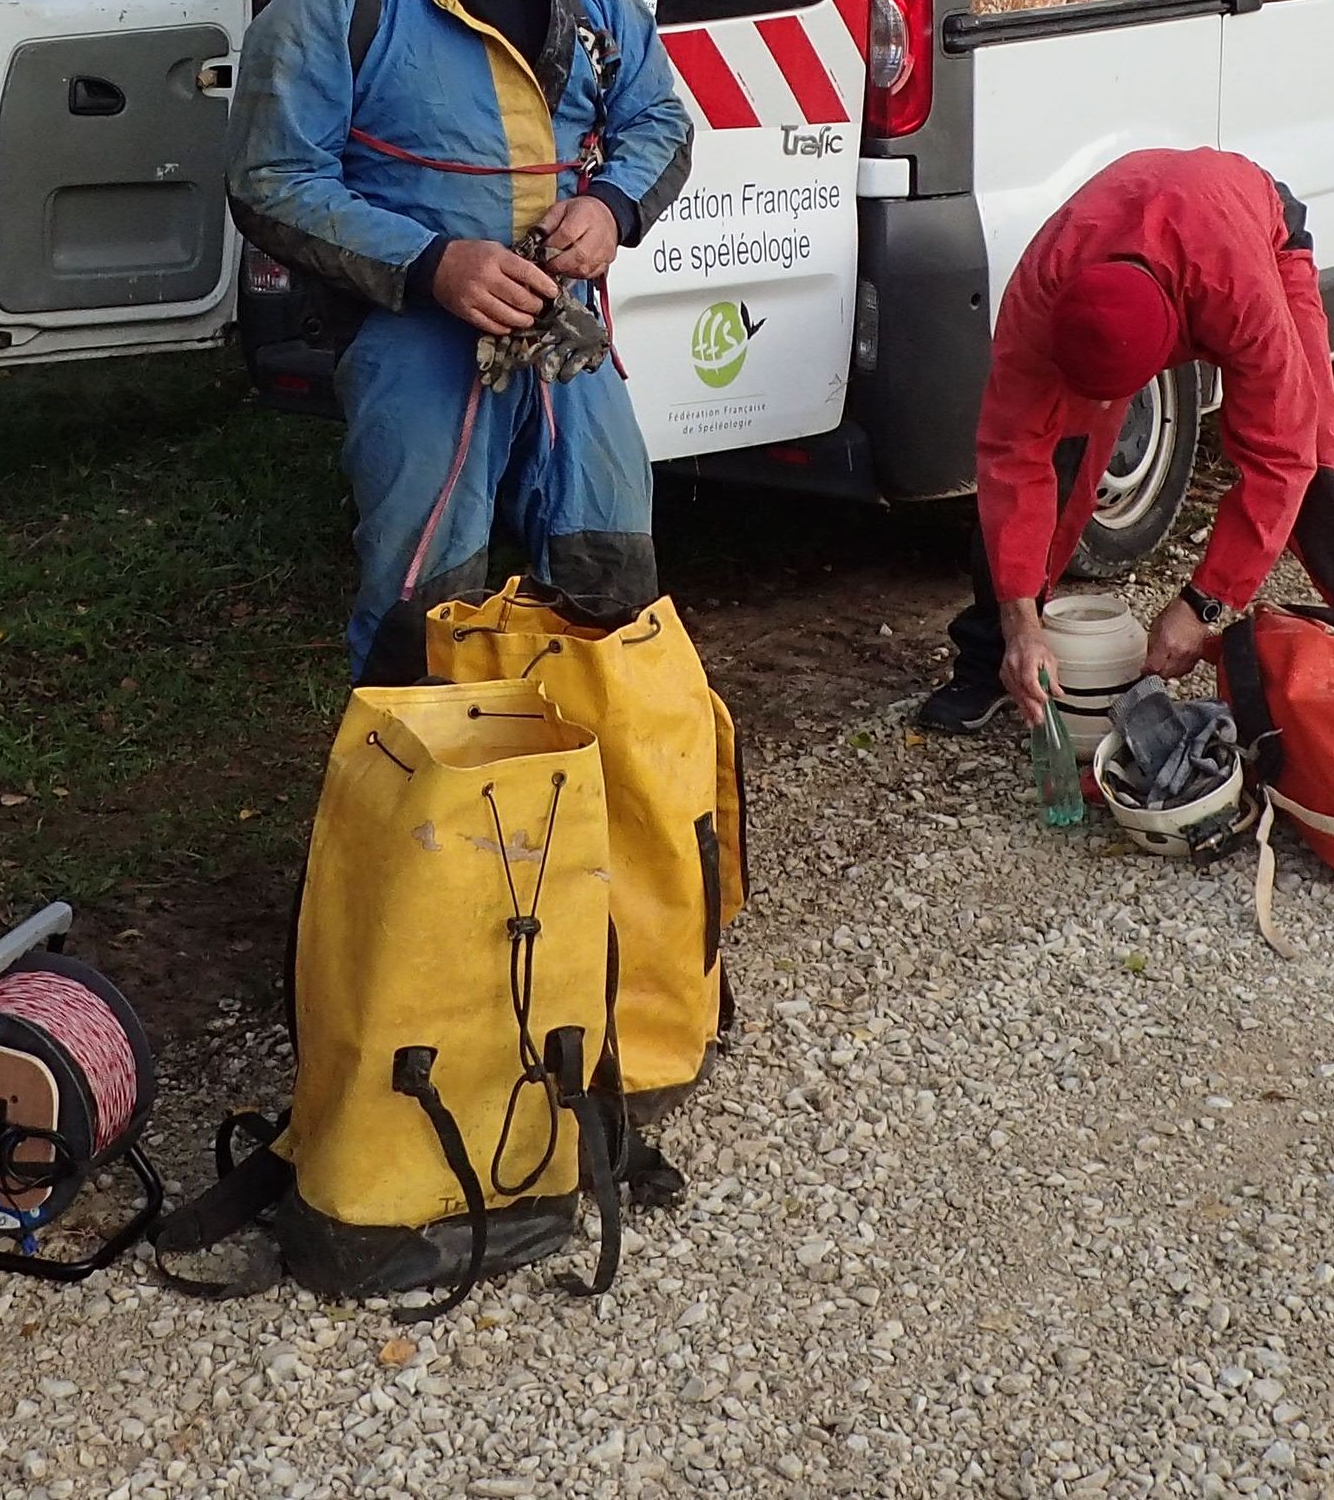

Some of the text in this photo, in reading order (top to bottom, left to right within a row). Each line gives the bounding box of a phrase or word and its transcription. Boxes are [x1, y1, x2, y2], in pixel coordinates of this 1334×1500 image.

[780, 123, 844, 157] Trafic
[658, 179, 840, 222] ration Française
[653, 228, 811, 277] de spéléologie
[668, 403, 767, 422] Fédération Française
[682, 418, 753, 435] de Spéléologie
